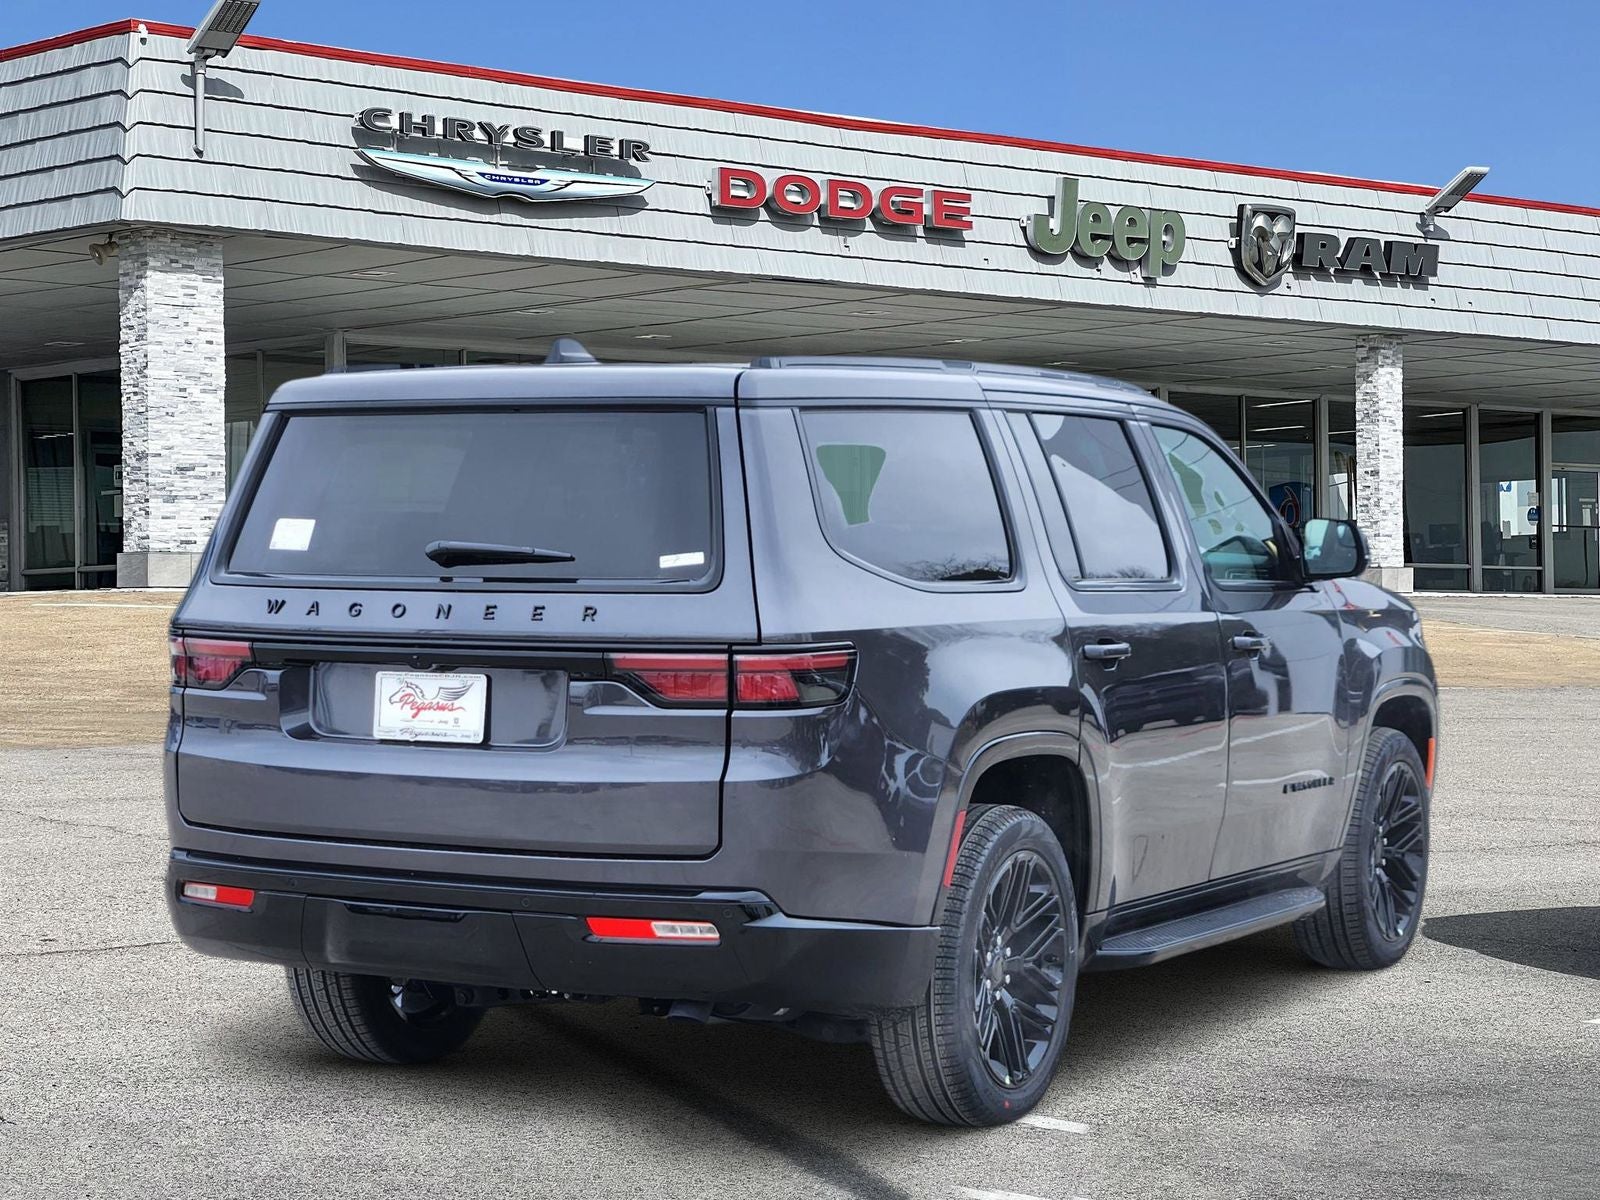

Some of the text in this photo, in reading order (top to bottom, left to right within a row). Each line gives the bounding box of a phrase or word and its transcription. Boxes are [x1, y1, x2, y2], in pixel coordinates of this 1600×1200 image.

[359, 107, 651, 162] CHRYSLER
[484, 174, 541, 185] CHRYSLER
[712, 167, 973, 231] DODGE
[1027, 177, 1186, 278] Jeep
[1295, 232, 1439, 277] RAM
[265, 598, 598, 622] WAGONEER
[400, 693, 465, 719] Pegasus
